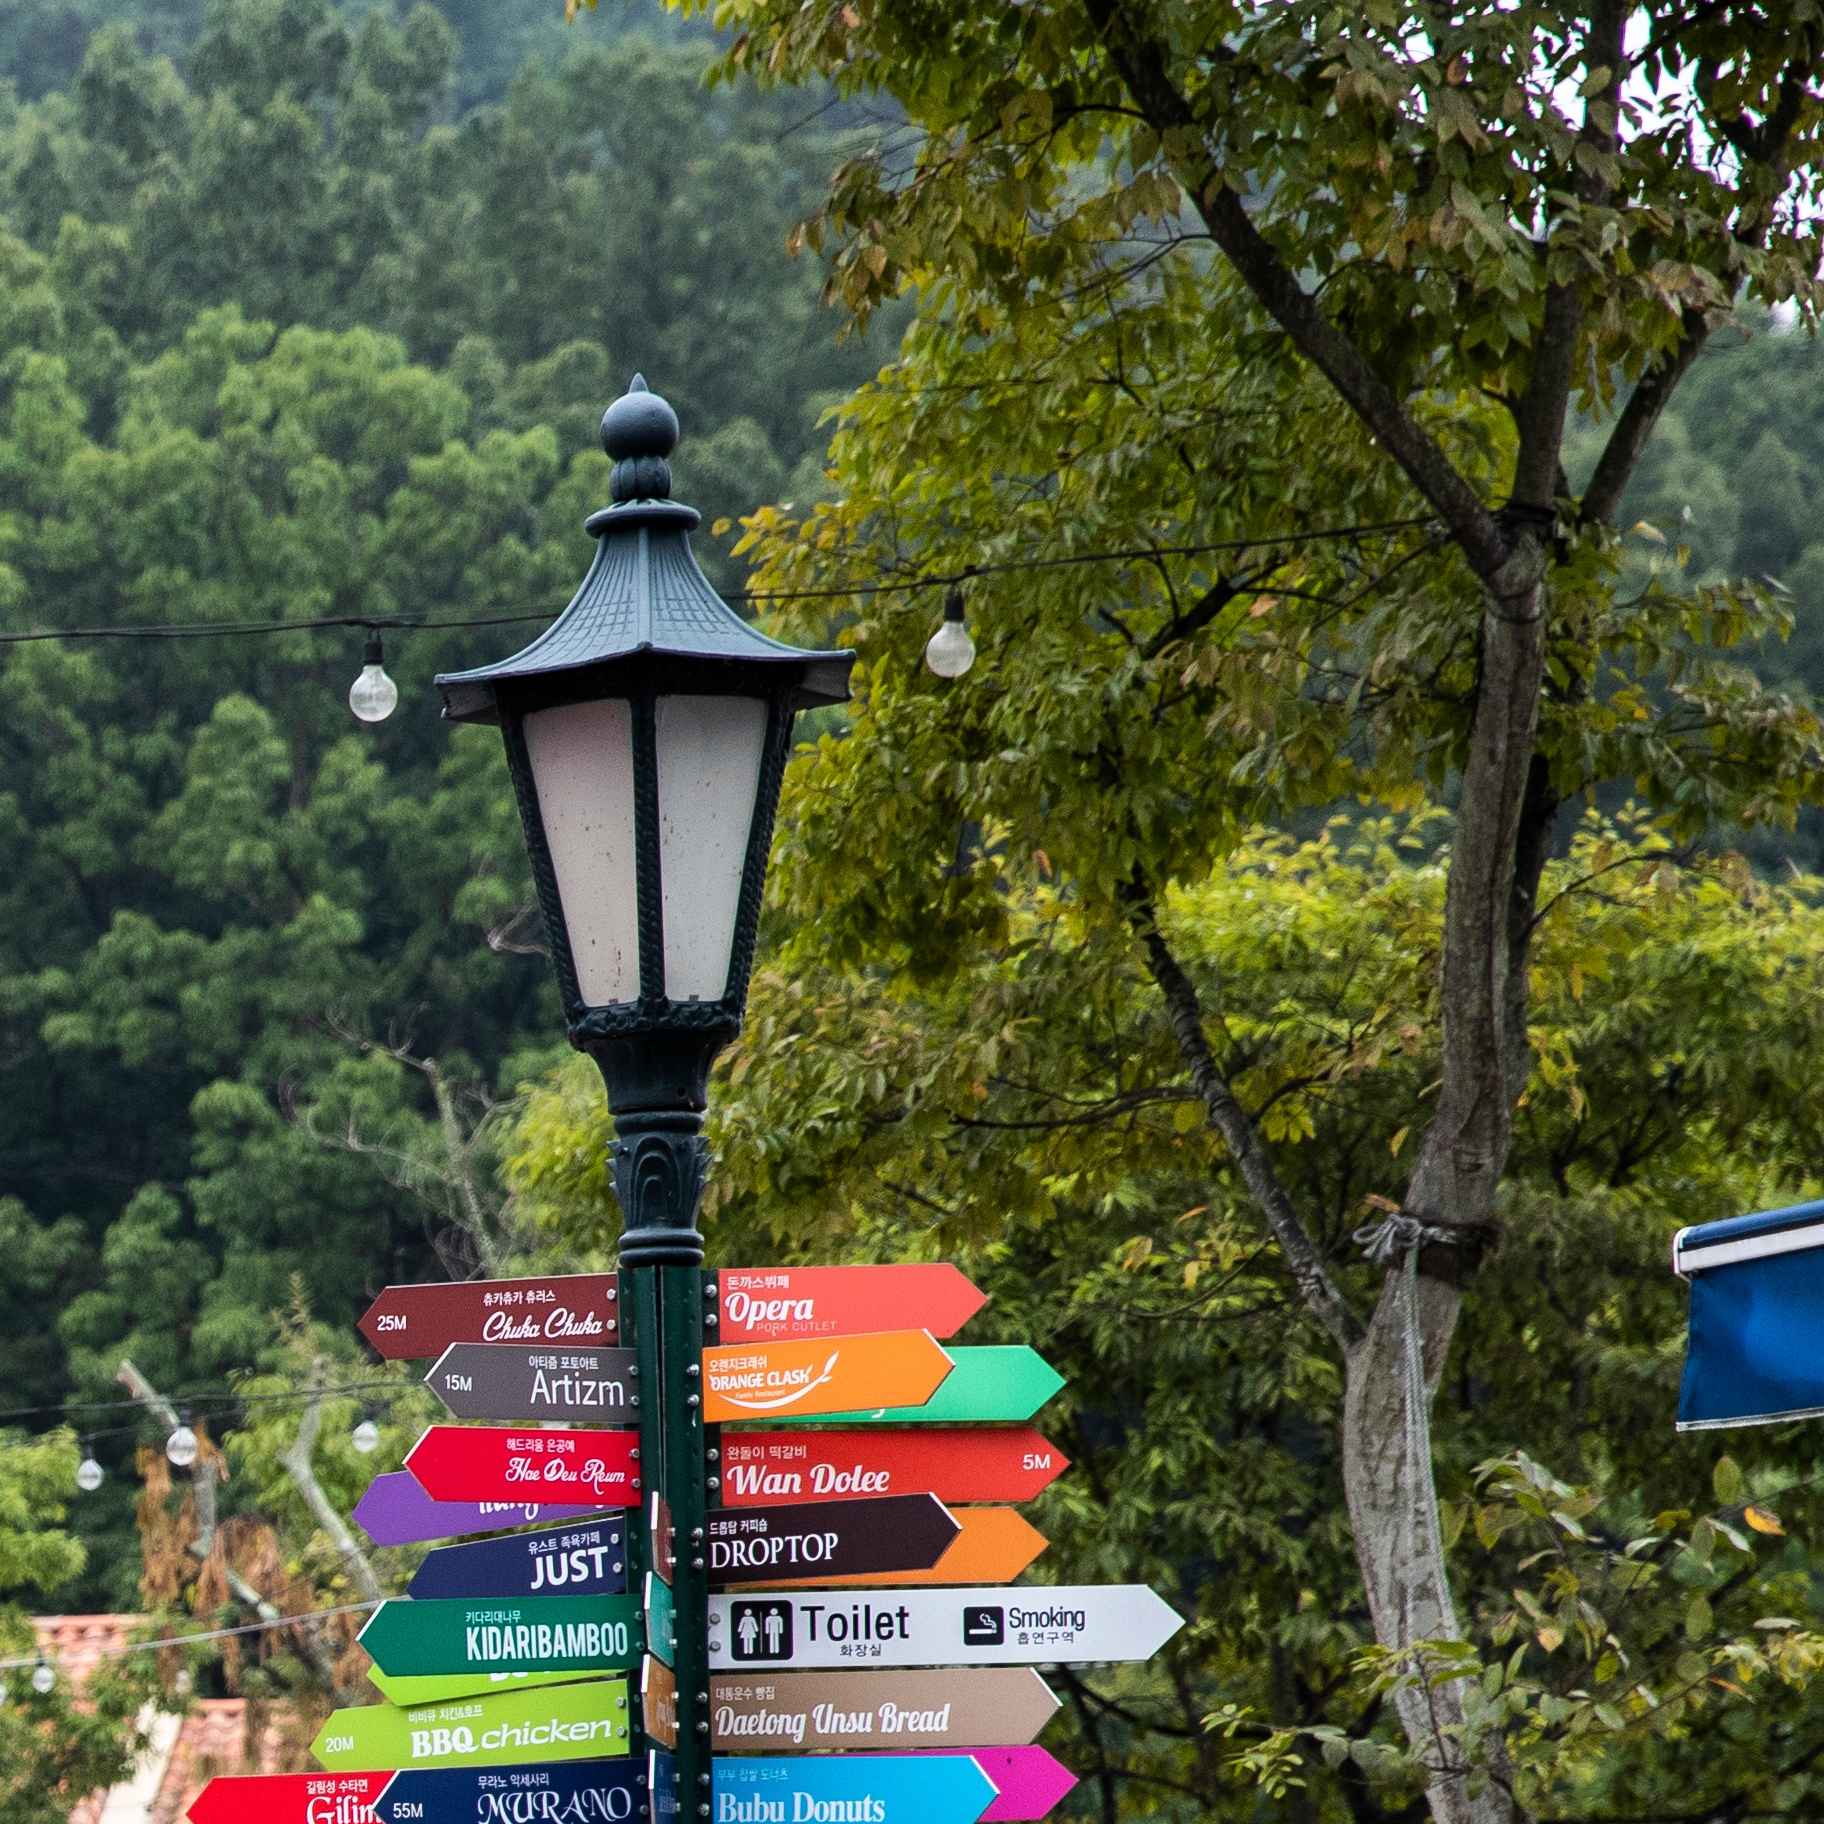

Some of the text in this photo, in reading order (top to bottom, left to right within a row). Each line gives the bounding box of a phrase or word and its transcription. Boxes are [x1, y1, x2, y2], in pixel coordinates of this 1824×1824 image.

[727, 1275, 790, 1290] 돈까스뷔페
[724, 1291, 814, 1331] Opera
[377, 1315, 407, 1331] 25M
[482, 1308, 603, 1342] Chuka Chuka
[528, 1355, 599, 1370] 아티즘 포토아트
[445, 1374, 472, 1392] 15M
[530, 1369, 624, 1406] Artizm
[708, 1372, 764, 1391] ORANGE
[727, 1445, 807, 1460] 완돌이 떡갈비
[1023, 1454, 1050, 1470] 5M
[726, 1463, 890, 1495] Wan Dolee
[739, 1518, 768, 1534] 커피숍
[528, 1537, 559, 1555] 유스트
[710, 1533, 839, 1569] DROPTOP
[530, 1546, 608, 1590] JUST
[465, 1610, 521, 1625] 키다리대나무
[800, 1603, 910, 1642] Toilet
[1008, 1607, 1086, 1631] Smoking
[466, 1622, 628, 1661] KIDARIBAMBOO
[1016, 1632, 1075, 1645] 흡연구역
[839, 1643, 882, 1658] 화장실
[754, 1686, 776, 1702] 빵집
[408, 1709, 436, 1723] 비비큐
[715, 1702, 951, 1744] Daetong Unsu Bread
[326, 1736, 354, 1752] 20M
[411, 1718, 612, 1758] BBQ chicken
[338, 1779, 369, 1793] 수타면
[478, 1773, 550, 1789] 무라노 악세사리
[393, 1803, 423, 1818] 55M
[718, 1791, 886, 1823] Bubu Donuts
